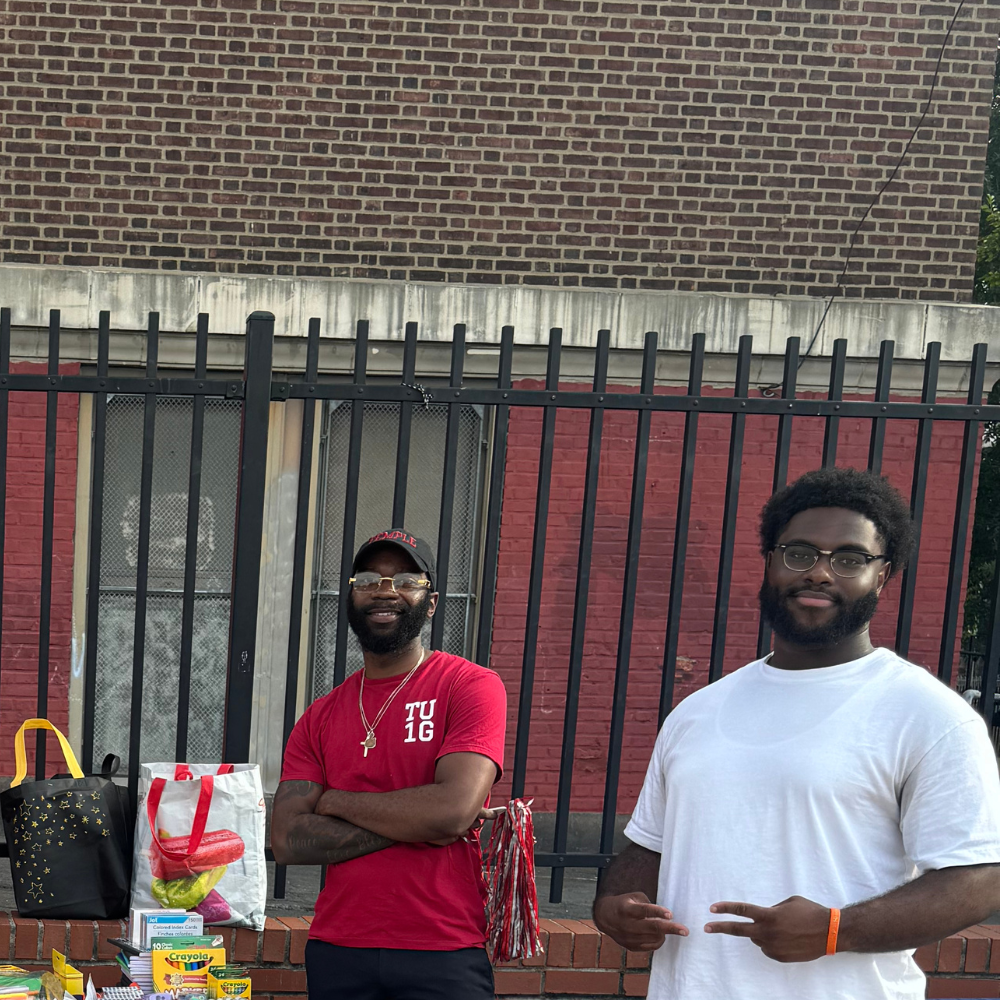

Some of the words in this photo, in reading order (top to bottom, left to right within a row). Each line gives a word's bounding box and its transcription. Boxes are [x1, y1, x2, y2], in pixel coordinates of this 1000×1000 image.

[368, 530, 417, 548] TEMPLE
[404, 698, 436, 722] TU
[403, 720, 434, 743] 1G
[169, 951, 208, 961] Crayola
